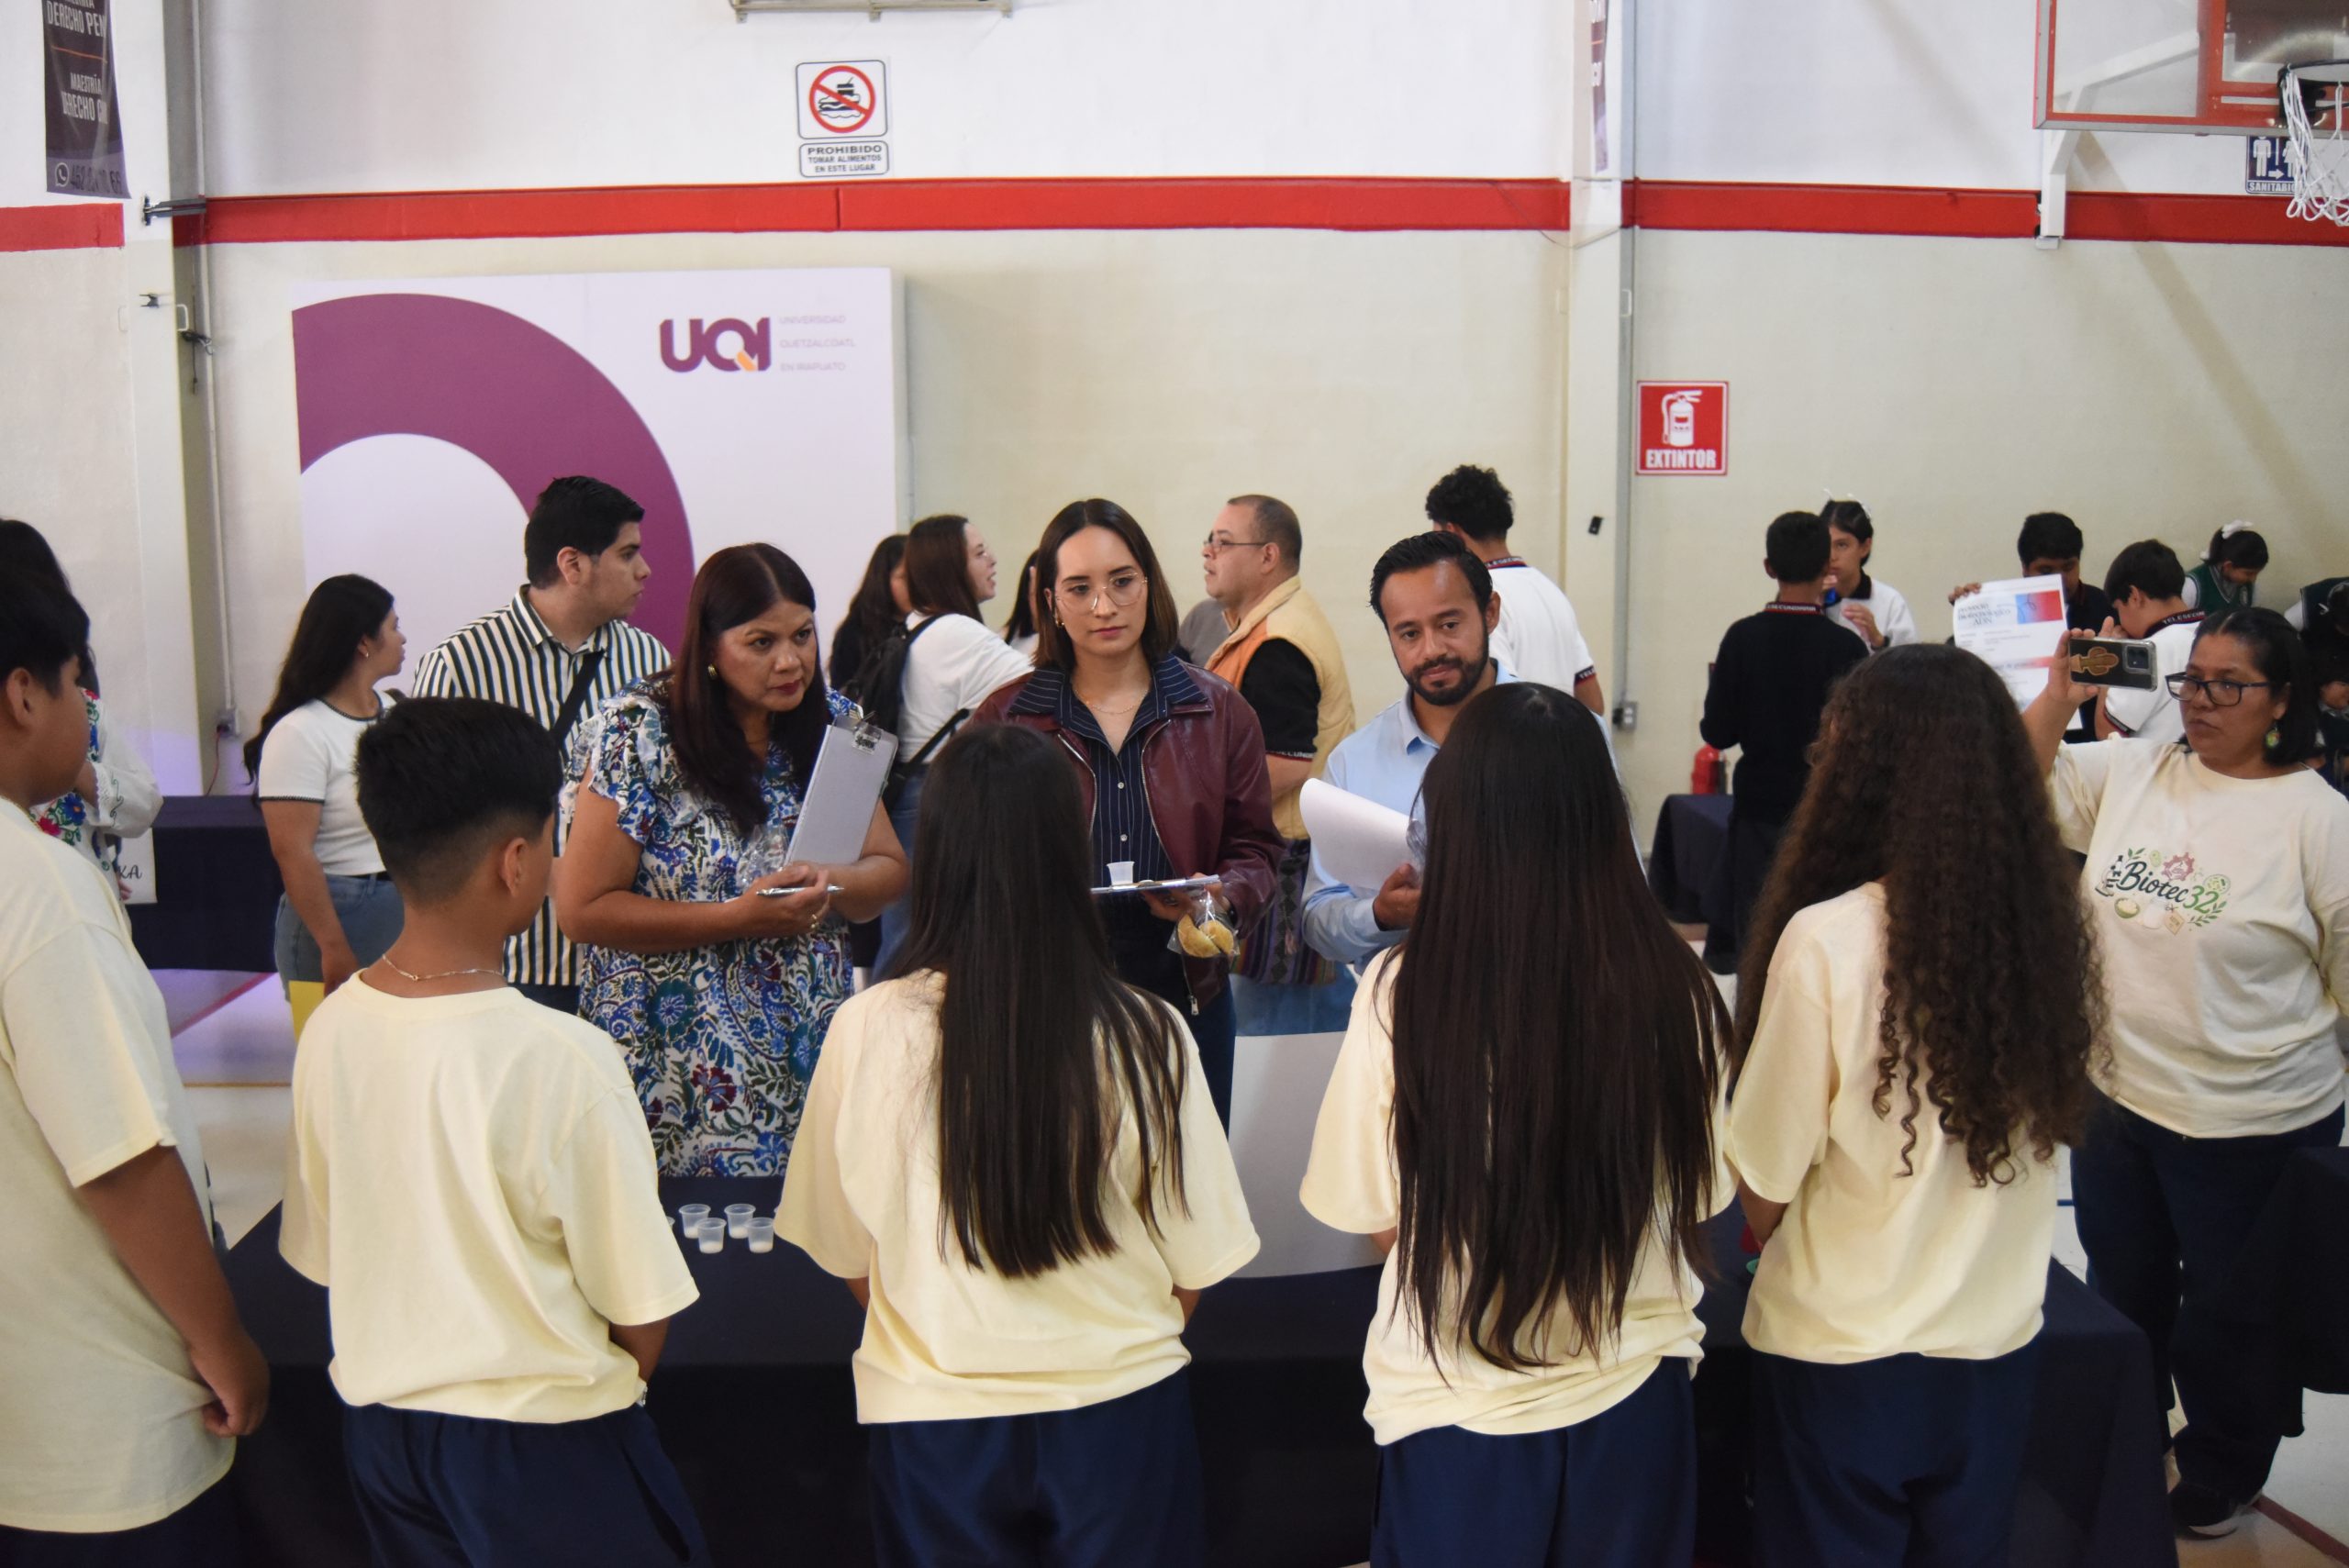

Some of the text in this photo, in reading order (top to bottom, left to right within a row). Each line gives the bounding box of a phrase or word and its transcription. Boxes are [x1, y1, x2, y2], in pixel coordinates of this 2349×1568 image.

[47, 1, 84, 34] DERECHO
[61, 90, 95, 120] DERECHO
[807, 145, 882, 155] PROHIBIDO
[838, 154, 882, 162] ALIMENTOS
[850, 163, 875, 172] LUGAR
[2249, 183, 2295, 192] SANITARI
[779, 315, 846, 324] UNIVERSIDAD
[780, 362, 794, 372] EN
[1645, 449, 1717, 469] EXTINTOR
